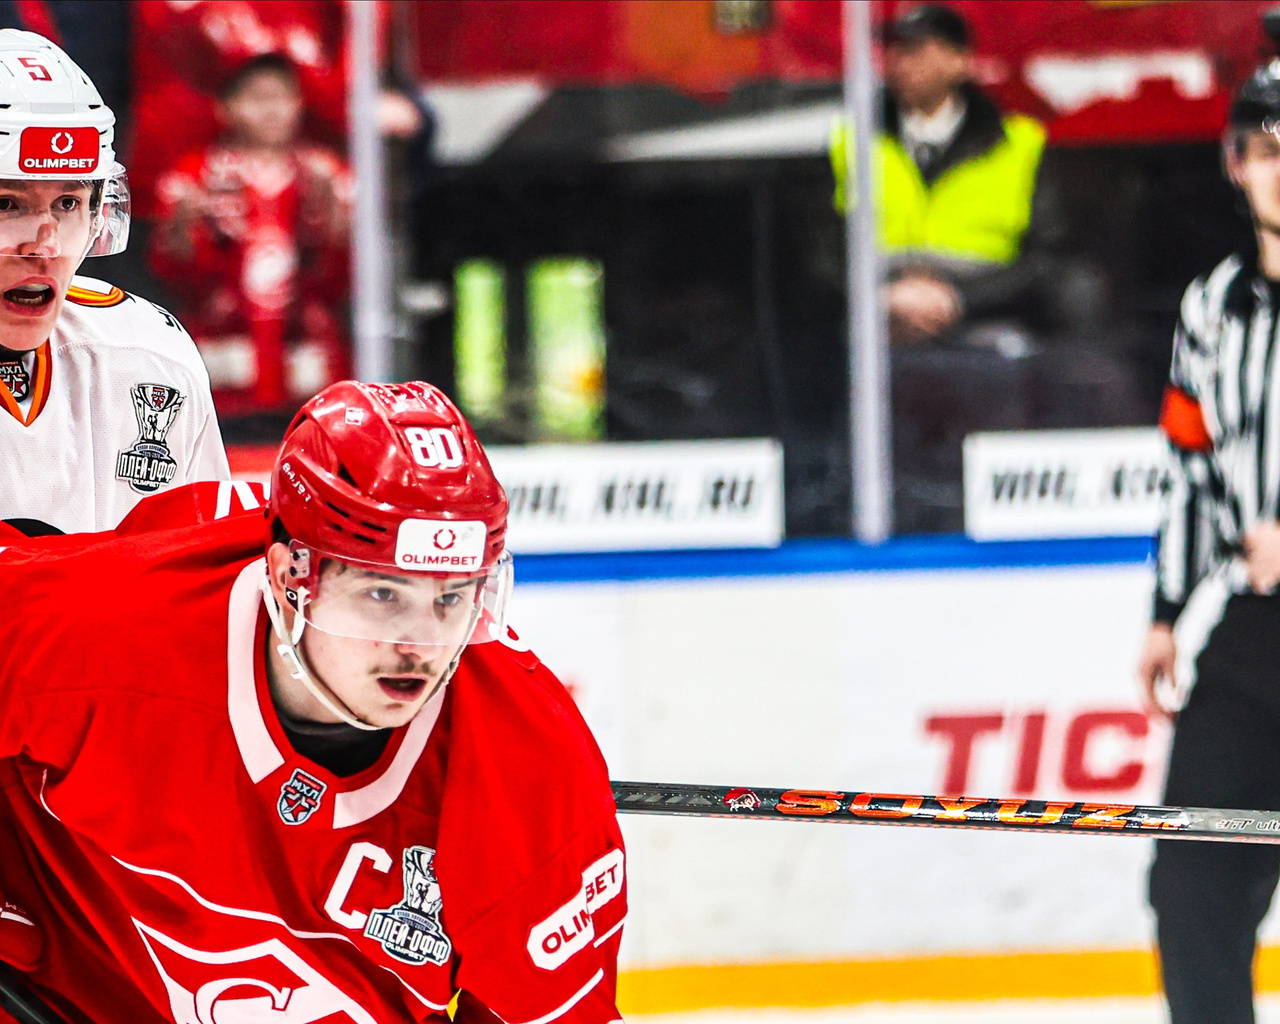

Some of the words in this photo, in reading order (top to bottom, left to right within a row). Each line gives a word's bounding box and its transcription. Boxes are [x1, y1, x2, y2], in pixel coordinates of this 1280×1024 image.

[17, 57, 54, 82] 5
[24, 157, 95, 169] OLIMPBET
[403, 426, 465, 469] 80
[119, 454, 177, 483] ПЛЕЙ-ОФФ
[402, 554, 478, 566] OLIMPBET
[924, 709, 1151, 794] TIC
[291, 779, 320, 800] МХЛ
[324, 842, 393, 929] C
[369, 913, 448, 961] ПЛЕЙ-ОФФ
